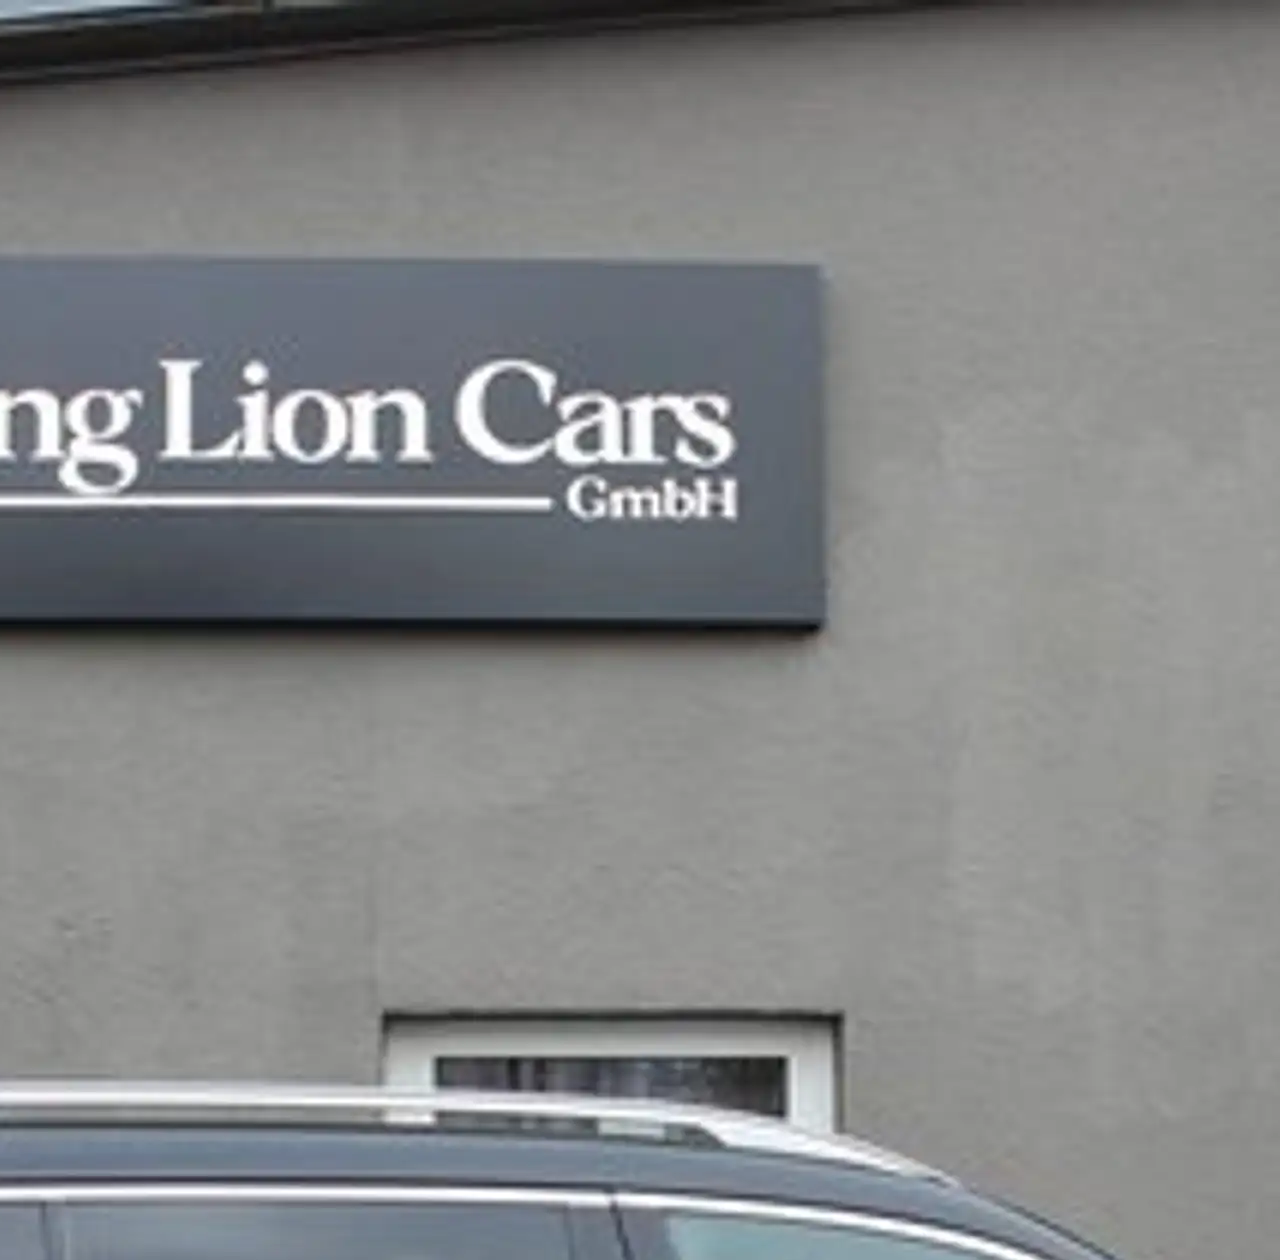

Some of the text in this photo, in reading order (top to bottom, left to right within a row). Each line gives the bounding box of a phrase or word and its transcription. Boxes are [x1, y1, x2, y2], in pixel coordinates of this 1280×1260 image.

[159, 357, 431, 464] Lion
[455, 357, 736, 468] Cars
[566, 475, 739, 521] GmbH
